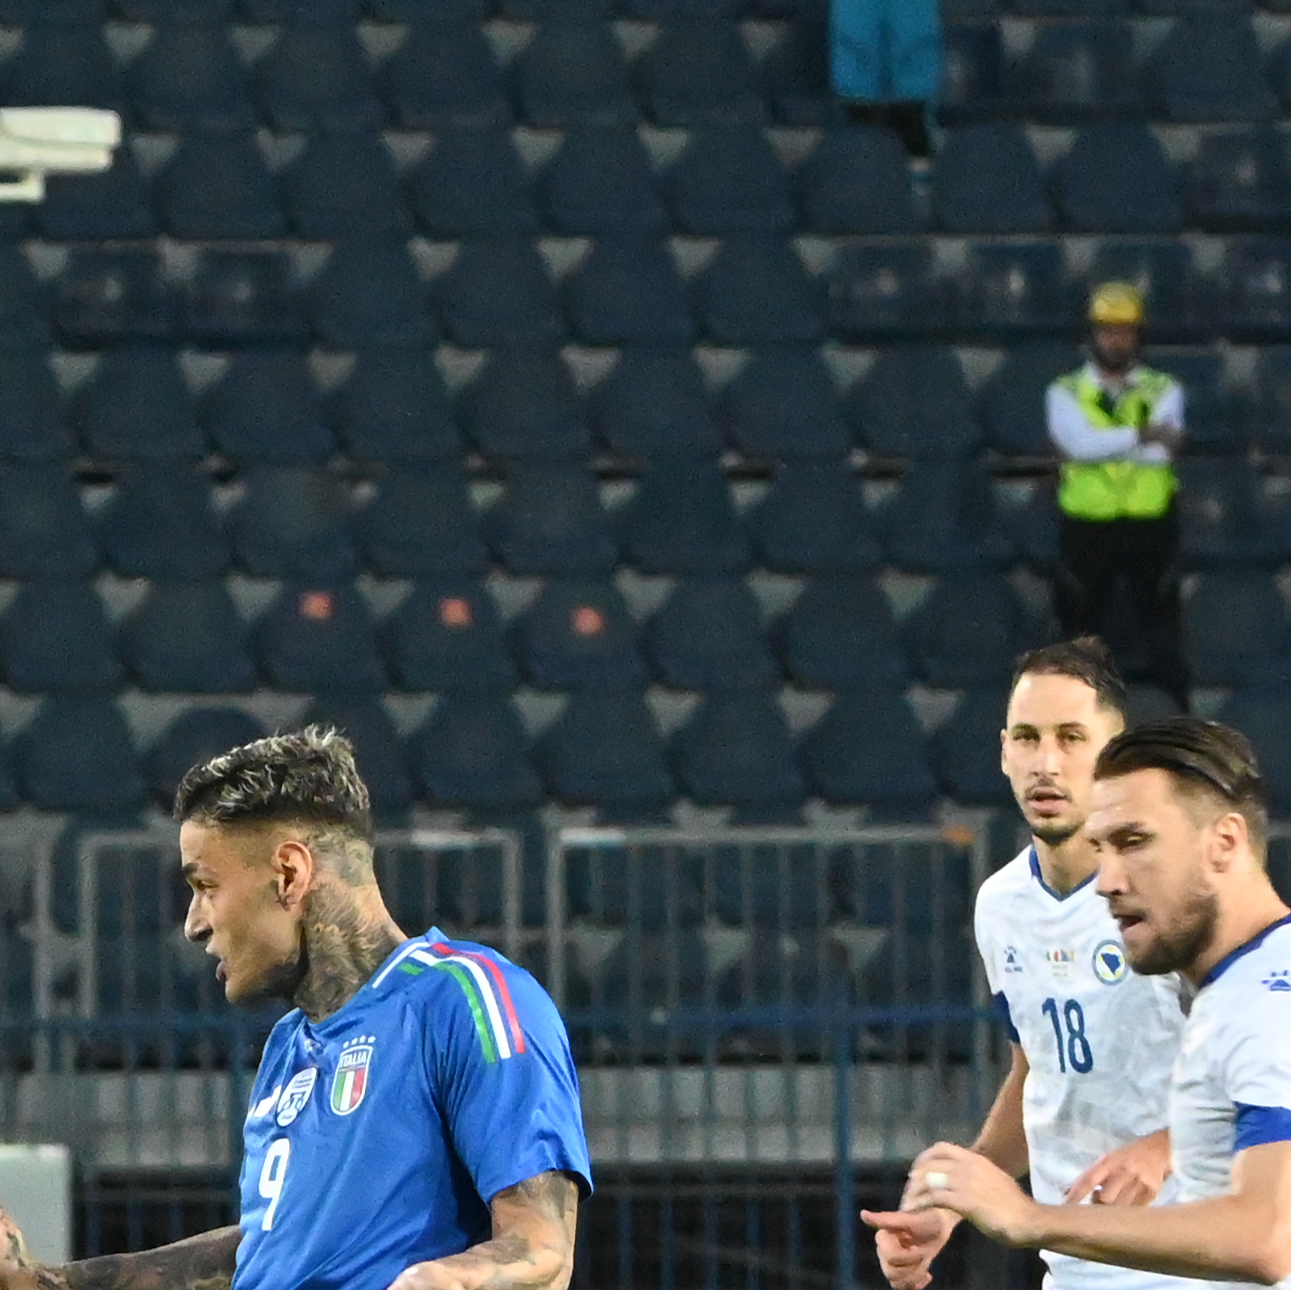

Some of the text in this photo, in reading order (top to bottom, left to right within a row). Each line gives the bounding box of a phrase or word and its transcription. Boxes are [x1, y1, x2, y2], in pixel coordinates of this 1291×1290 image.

[339, 1050, 368, 1067] ITALIA
[1041, 997, 1094, 1074] 18
[258, 1138, 290, 1231] 9
